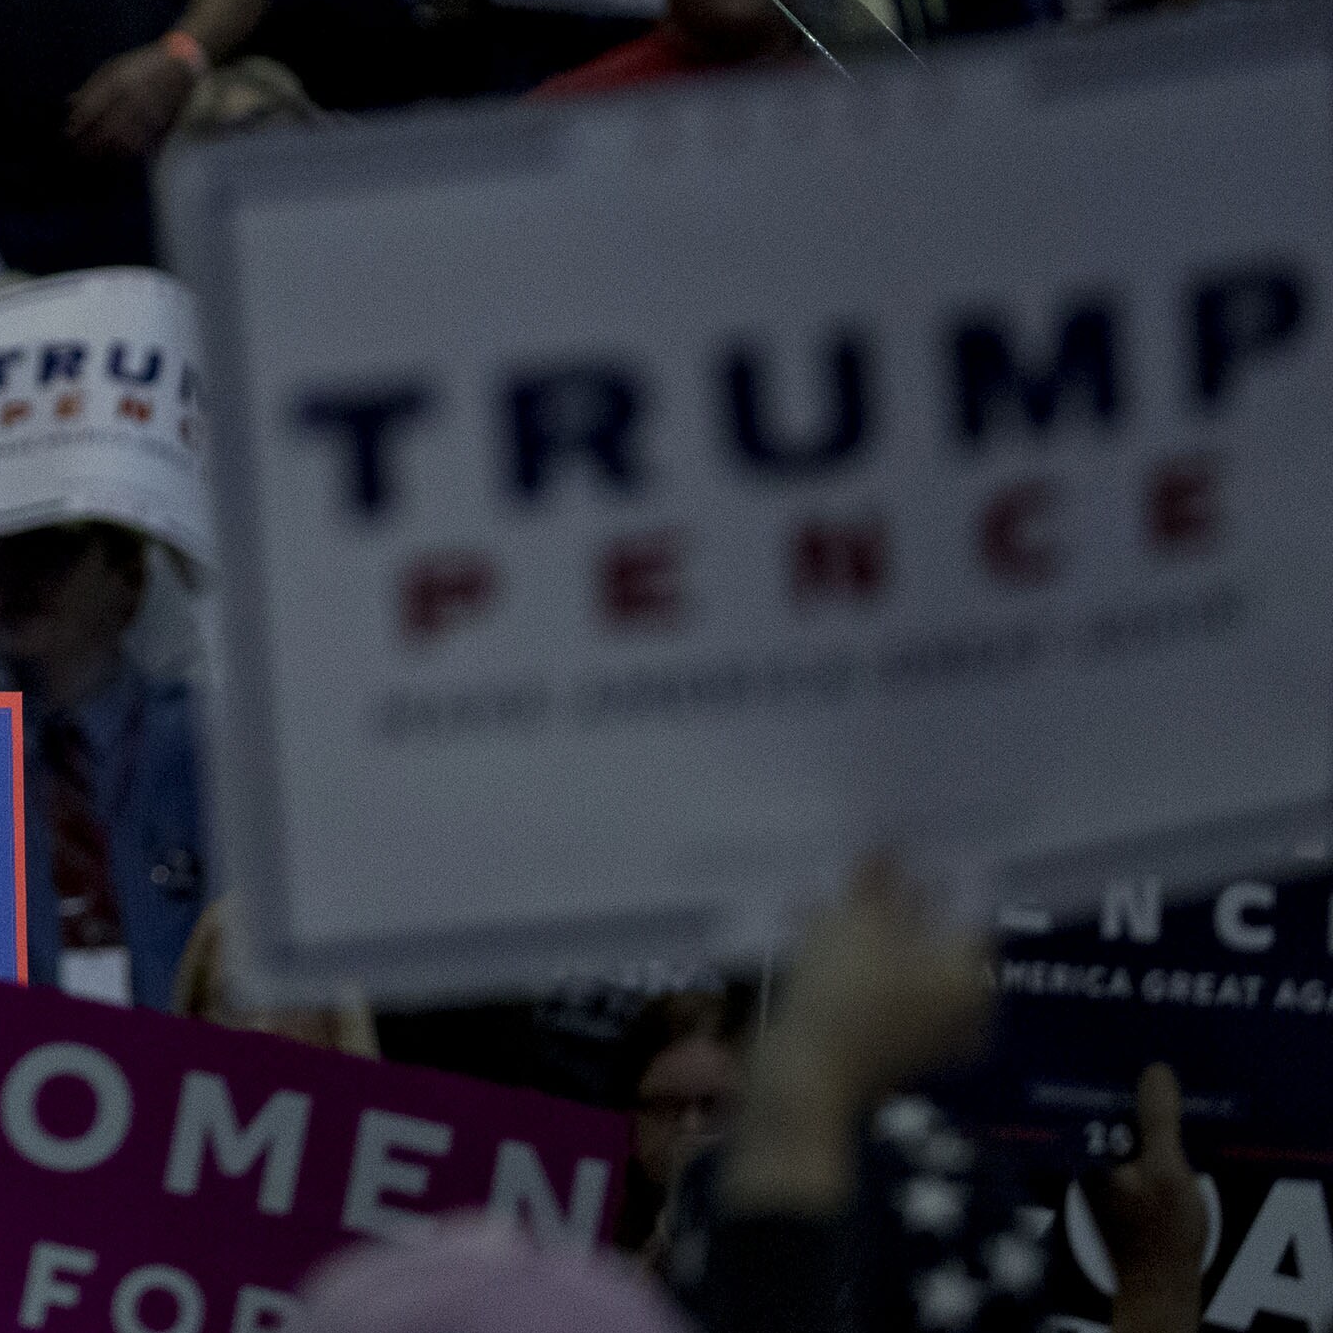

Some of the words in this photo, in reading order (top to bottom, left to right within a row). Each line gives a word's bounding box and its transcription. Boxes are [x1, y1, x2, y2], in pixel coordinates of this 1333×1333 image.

[297, 269, 1302, 510] TRUMP
[400, 470, 1215, 639] PENCE
[1140, 967, 1266, 1010] GREAT
